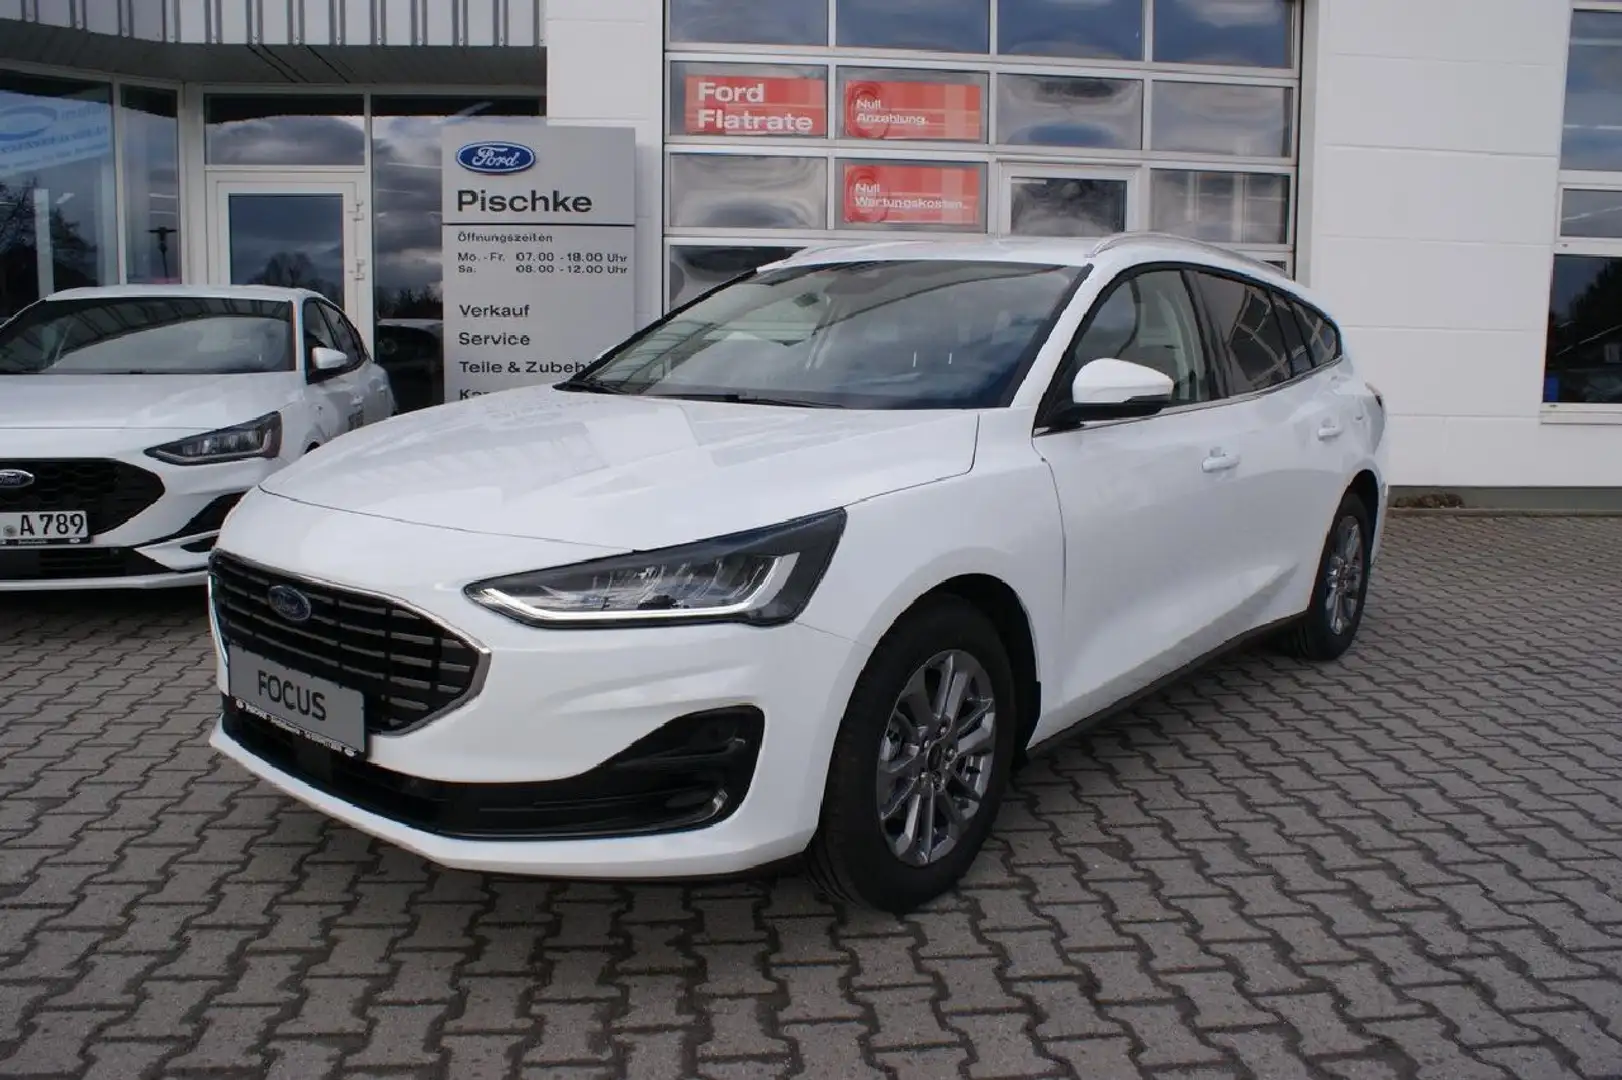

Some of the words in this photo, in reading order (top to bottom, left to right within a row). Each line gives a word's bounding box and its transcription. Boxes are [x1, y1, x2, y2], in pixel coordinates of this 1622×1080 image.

[698, 82, 764, 103] Ford
[856, 99, 881, 110] Null
[698, 109, 813, 131] Flatrate
[472, 146, 520, 167] Ford
[855, 183, 880, 193] Null
[457, 189, 592, 213] Pischke
[457, 231, 553, 243] Öffnungszeiten
[516, 252, 554, 262] 07.00
[567, 252, 603, 262] 18.00
[607, 253, 628, 263] Uhr
[516, 264, 554, 274] 08.00
[567, 264, 603, 274] 12.00
[607, 265, 628, 274] Uhr
[459, 304, 530, 318] Verkauf
[459, 332, 531, 346] Service
[459, 361, 502, 373] Teile
[508, 361, 520, 373] &
[20, 514, 35, 536] A
[39, 513, 84, 535] 789
[257, 670, 328, 721] FOCUS
